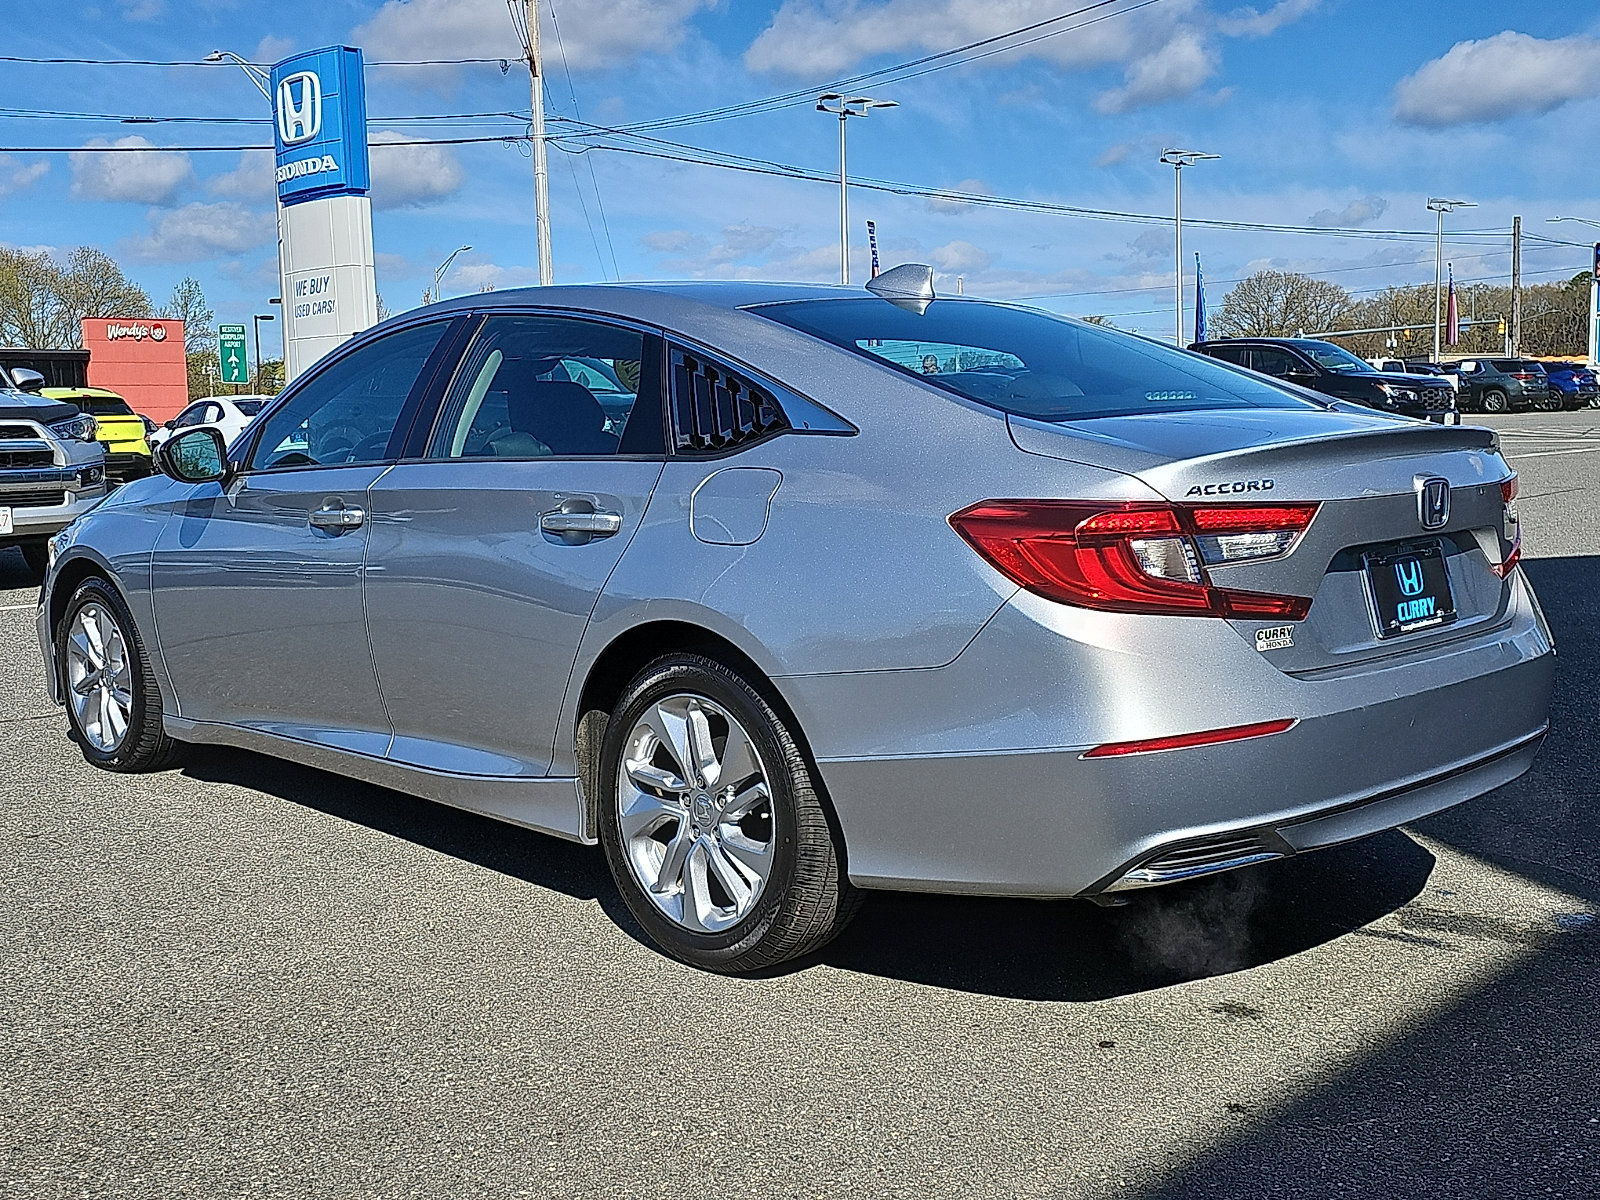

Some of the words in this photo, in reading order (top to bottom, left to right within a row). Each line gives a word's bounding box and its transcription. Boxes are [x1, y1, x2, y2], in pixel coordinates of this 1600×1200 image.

[275, 154, 339, 183] HONDA
[295, 279, 308, 297] WE
[309, 275, 330, 295] BUY
[294, 302, 310, 318] USED
[312, 299, 335, 316] CARS!
[107, 321, 148, 341] Wendy's
[1183, 479, 1275, 498] ACCORD
[1397, 596, 1436, 622] CURRY
[1256, 626, 1293, 641] CURRY
[1265, 639, 1294, 649] HONDA
